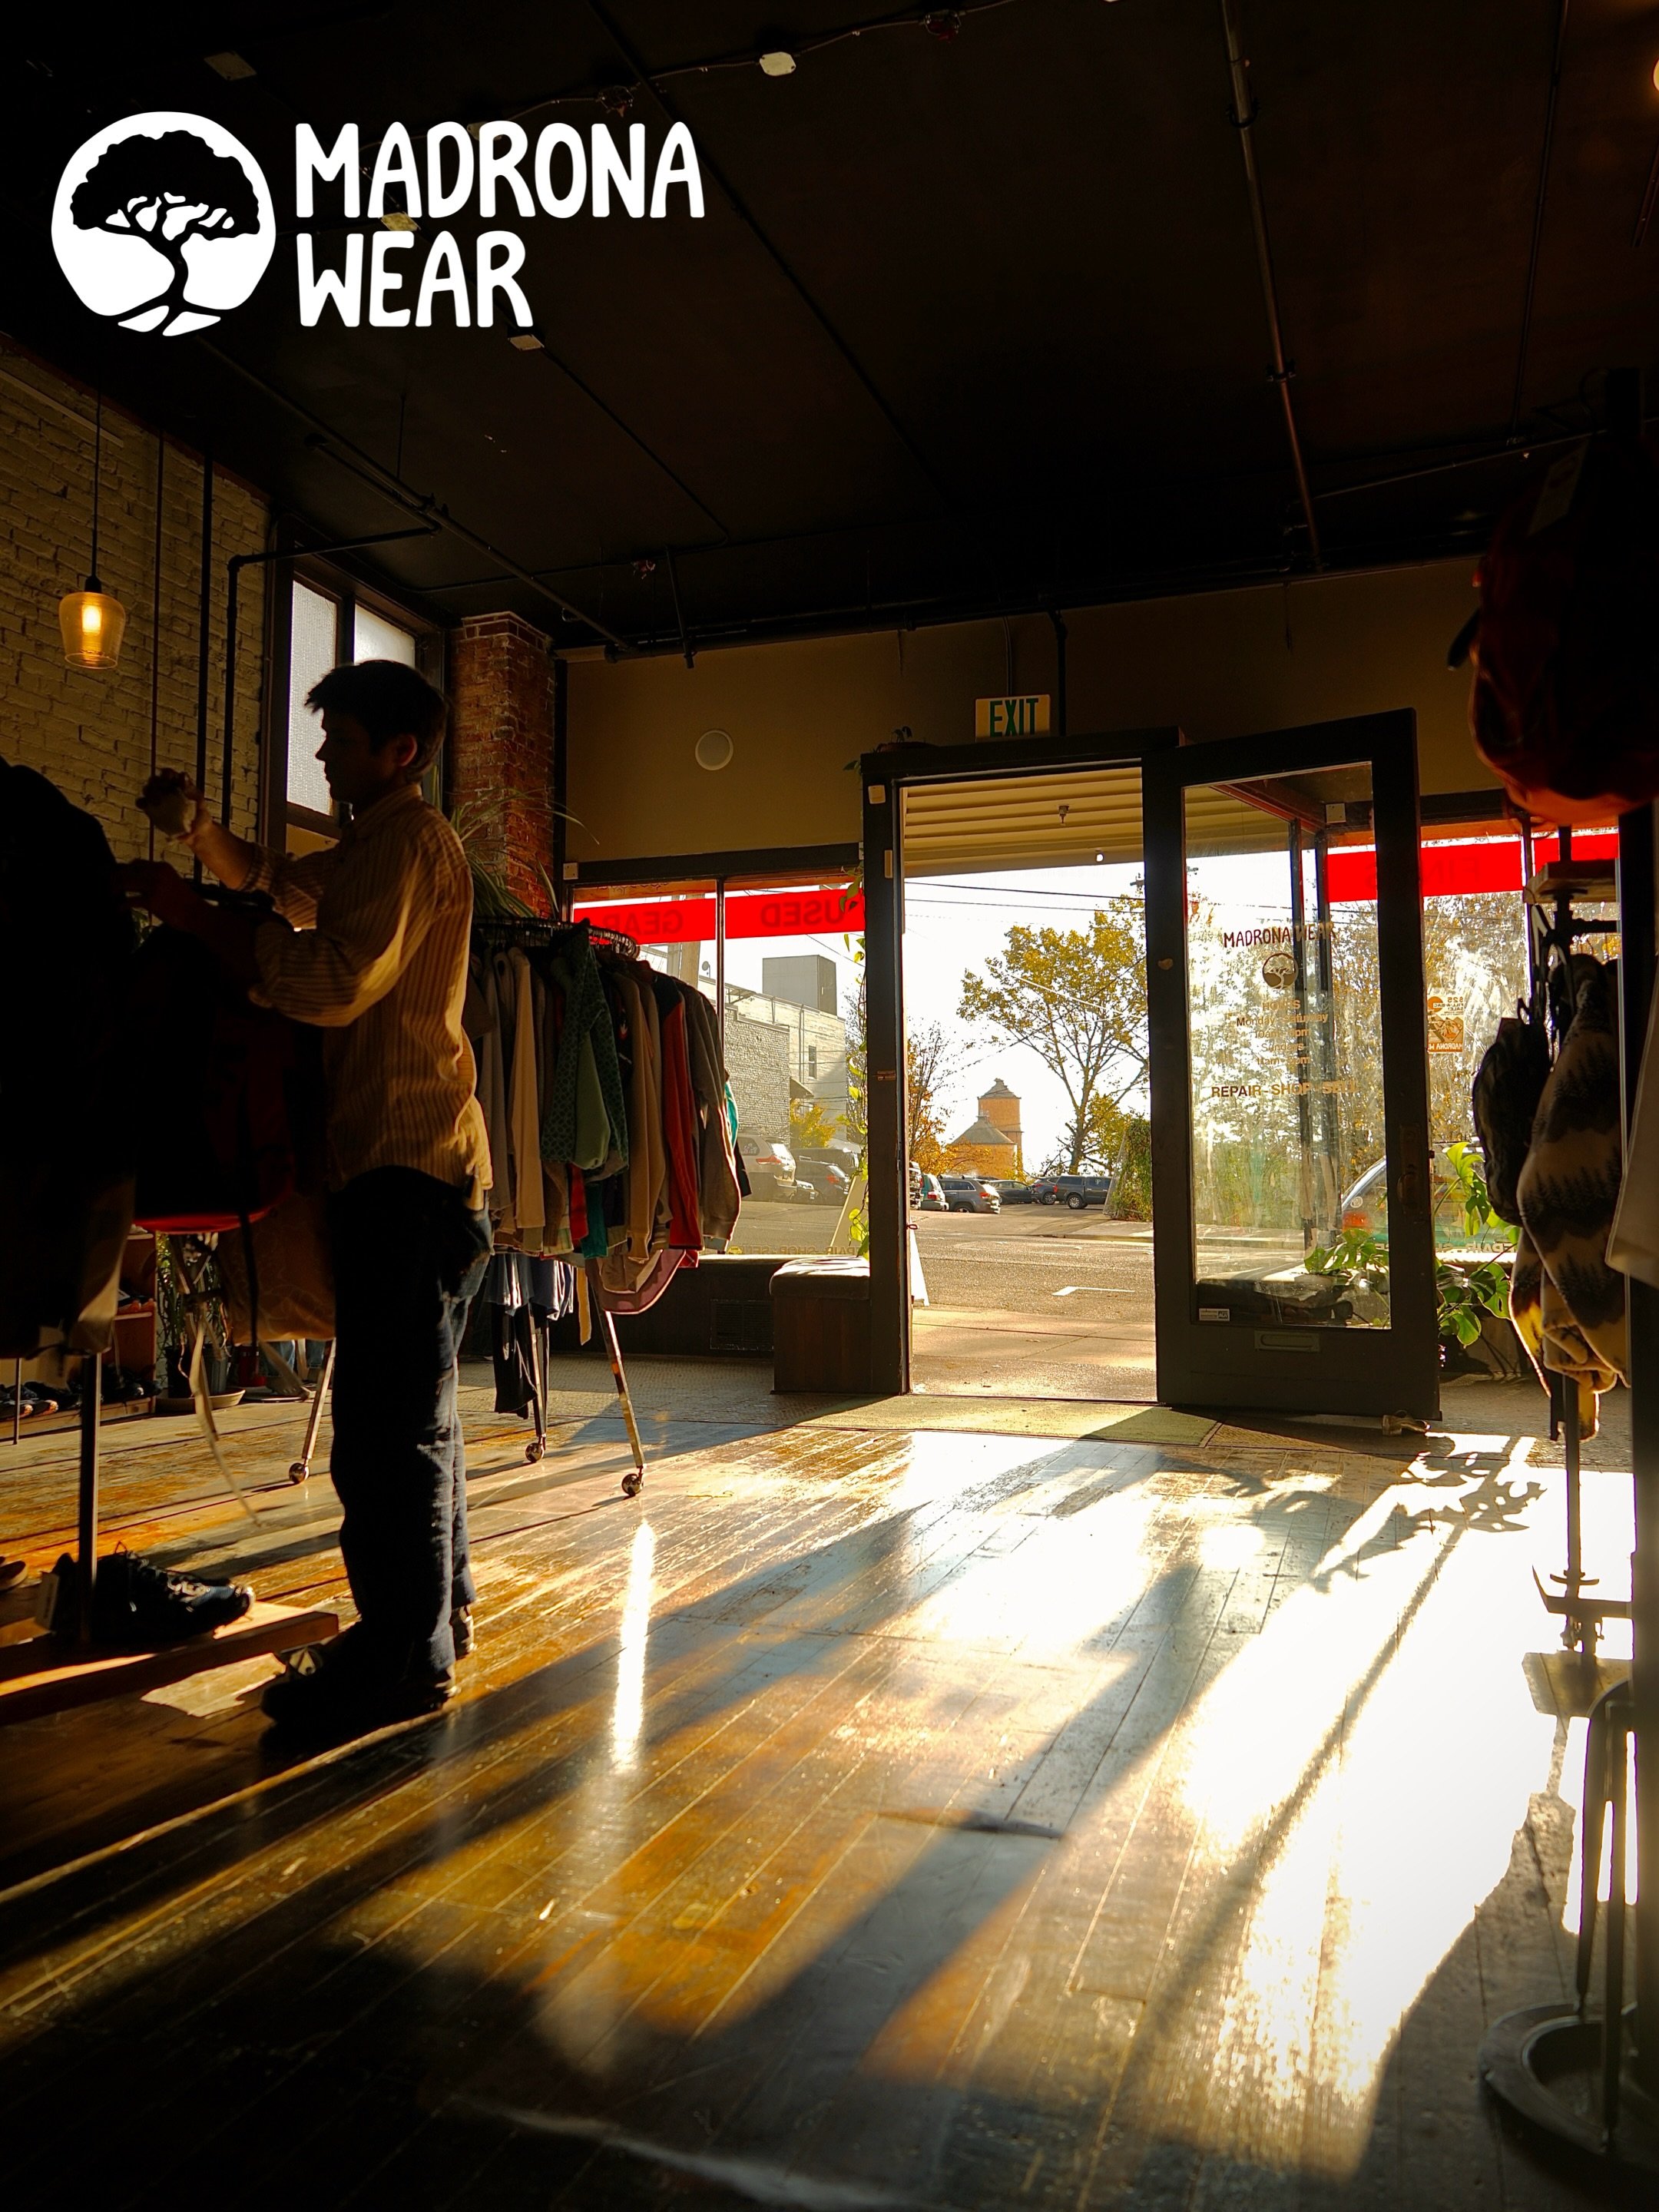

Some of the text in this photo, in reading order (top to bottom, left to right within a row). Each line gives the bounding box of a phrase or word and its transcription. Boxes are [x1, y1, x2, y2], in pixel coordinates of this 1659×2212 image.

[990, 698, 1038, 737] EXIT
[1223, 921, 1336, 948] MADRONA WEAR
[1236, 1016, 1276, 1027] Monday
[1211, 1084, 1262, 1098] REPAIR
[1271, 1082, 1313, 1096] SHOP
